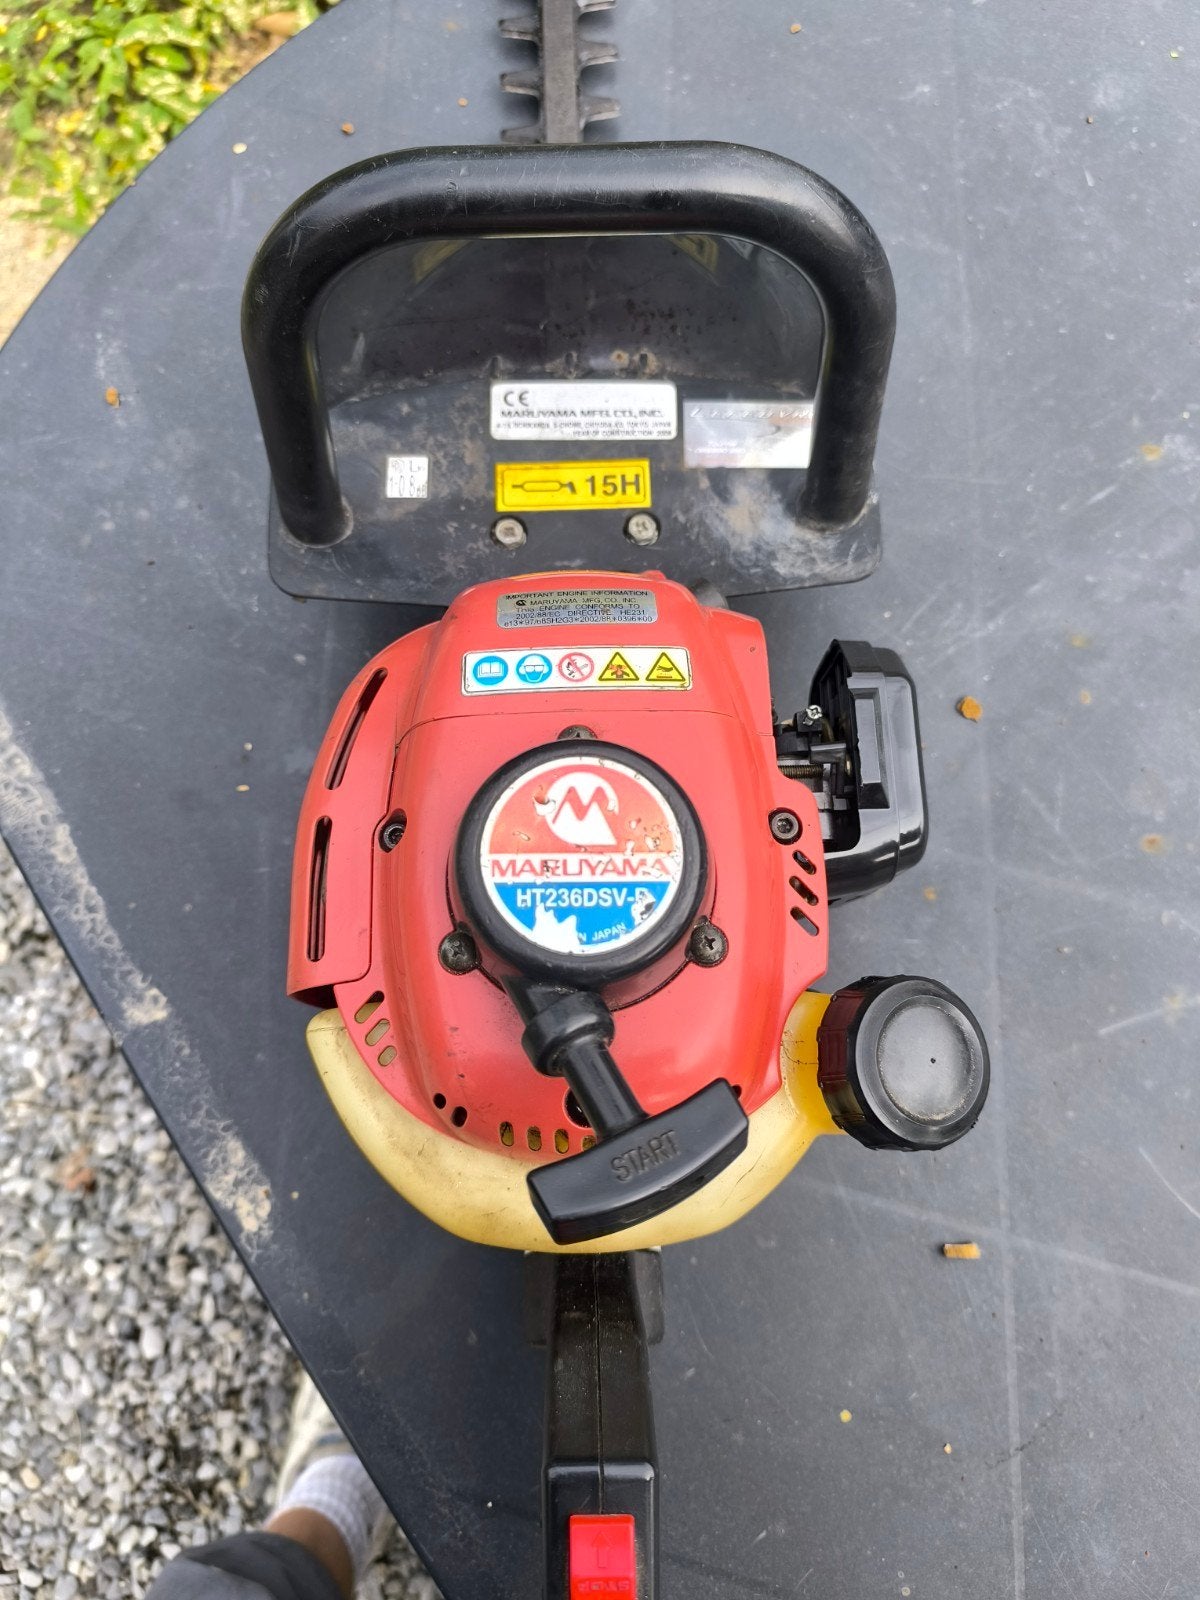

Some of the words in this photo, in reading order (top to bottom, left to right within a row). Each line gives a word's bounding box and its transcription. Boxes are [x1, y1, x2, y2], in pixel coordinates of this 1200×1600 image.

[503, 391, 529, 407] CE
[501, 409, 576, 418] MARUYAMA
[586, 474, 640, 497] 15H
[505, 592, 554, 600] IMPORTANT
[530, 598, 578, 606] MARUYAMA
[540, 604, 571, 612] ENGINE
[492, 858, 671, 877] MARUYAMA
[592, 922, 627, 942] JAPAN
[610, 1129, 680, 1183] START
